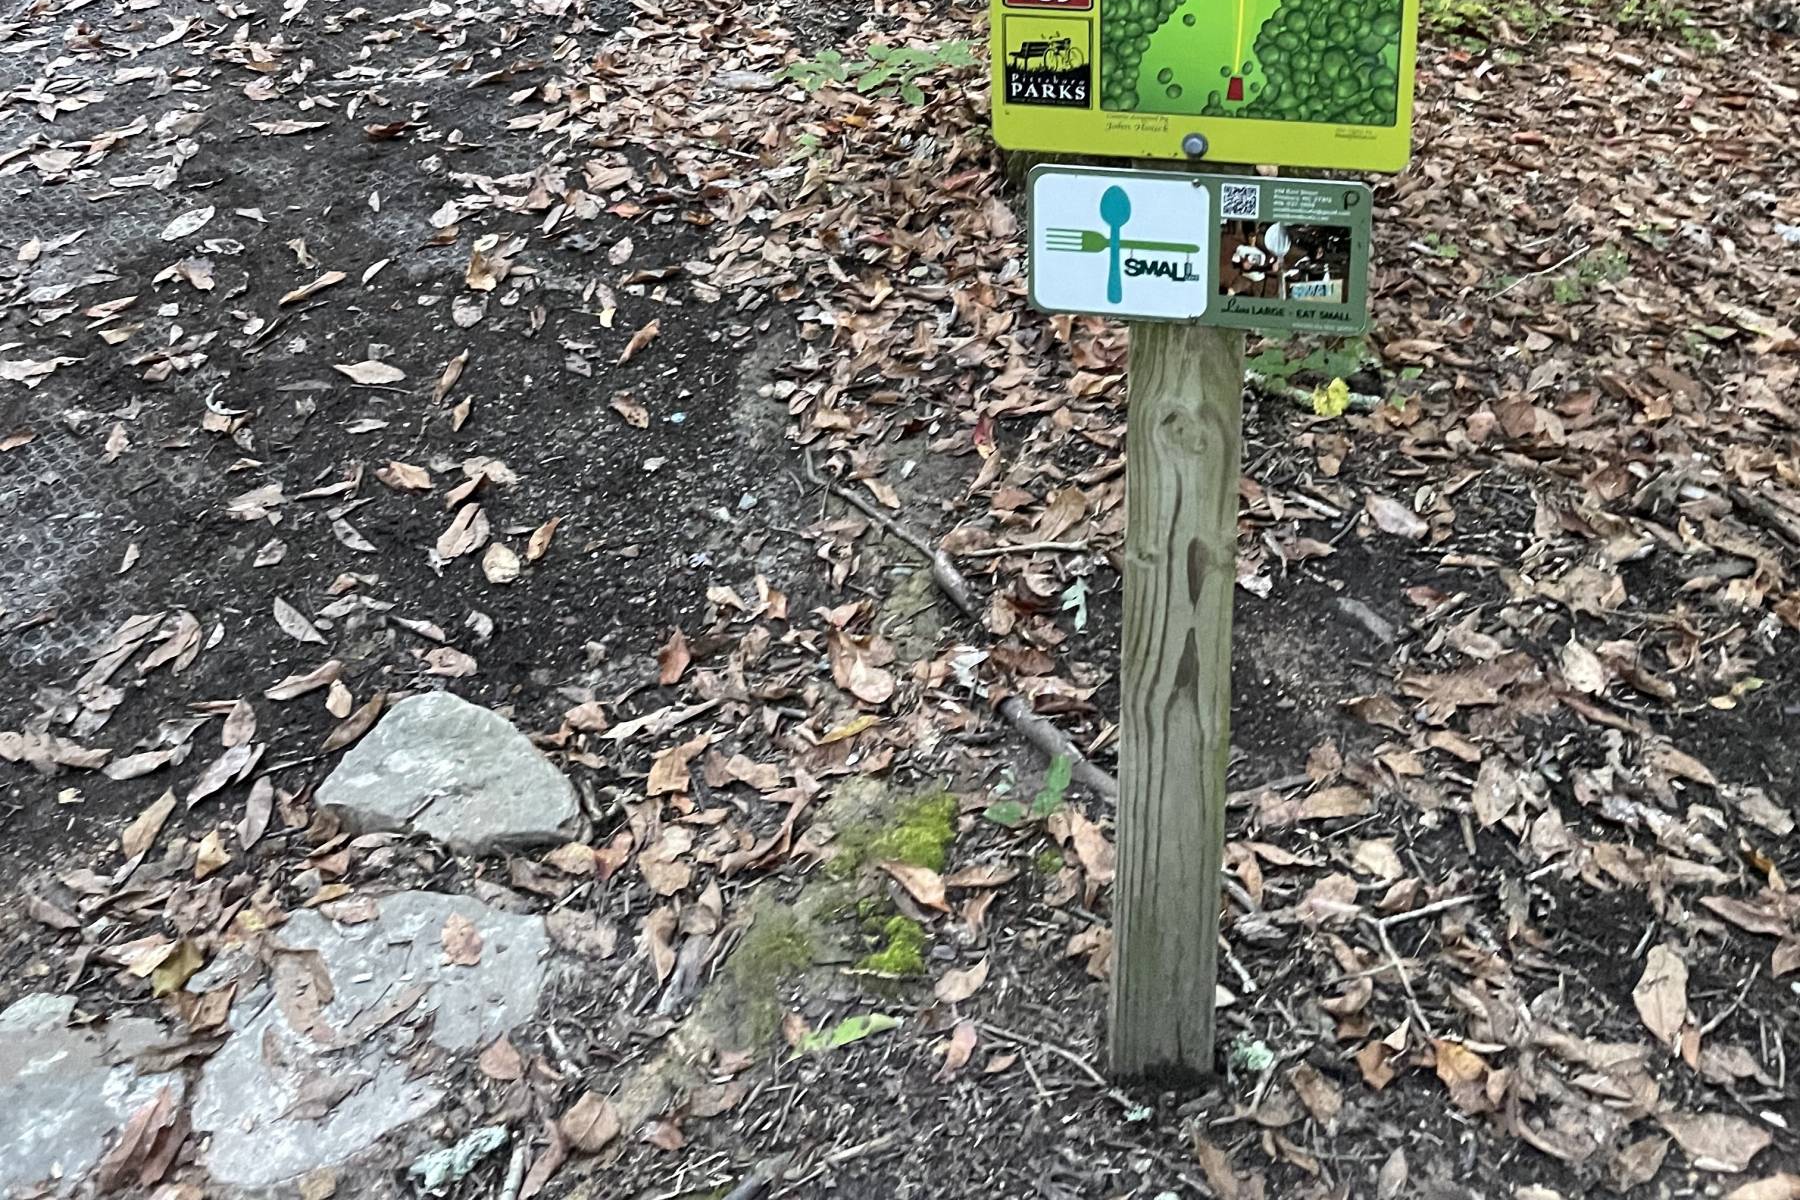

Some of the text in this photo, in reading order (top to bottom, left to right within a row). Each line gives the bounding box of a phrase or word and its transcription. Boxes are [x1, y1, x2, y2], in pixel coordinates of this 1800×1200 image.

[1011, 82, 1086, 100] PARKS
[1124, 258, 1199, 282] SMALL
[1251, 306, 1285, 317] LARGE
[1296, 310, 1318, 319] EAT
[1319, 311, 1353, 322] SMALL
